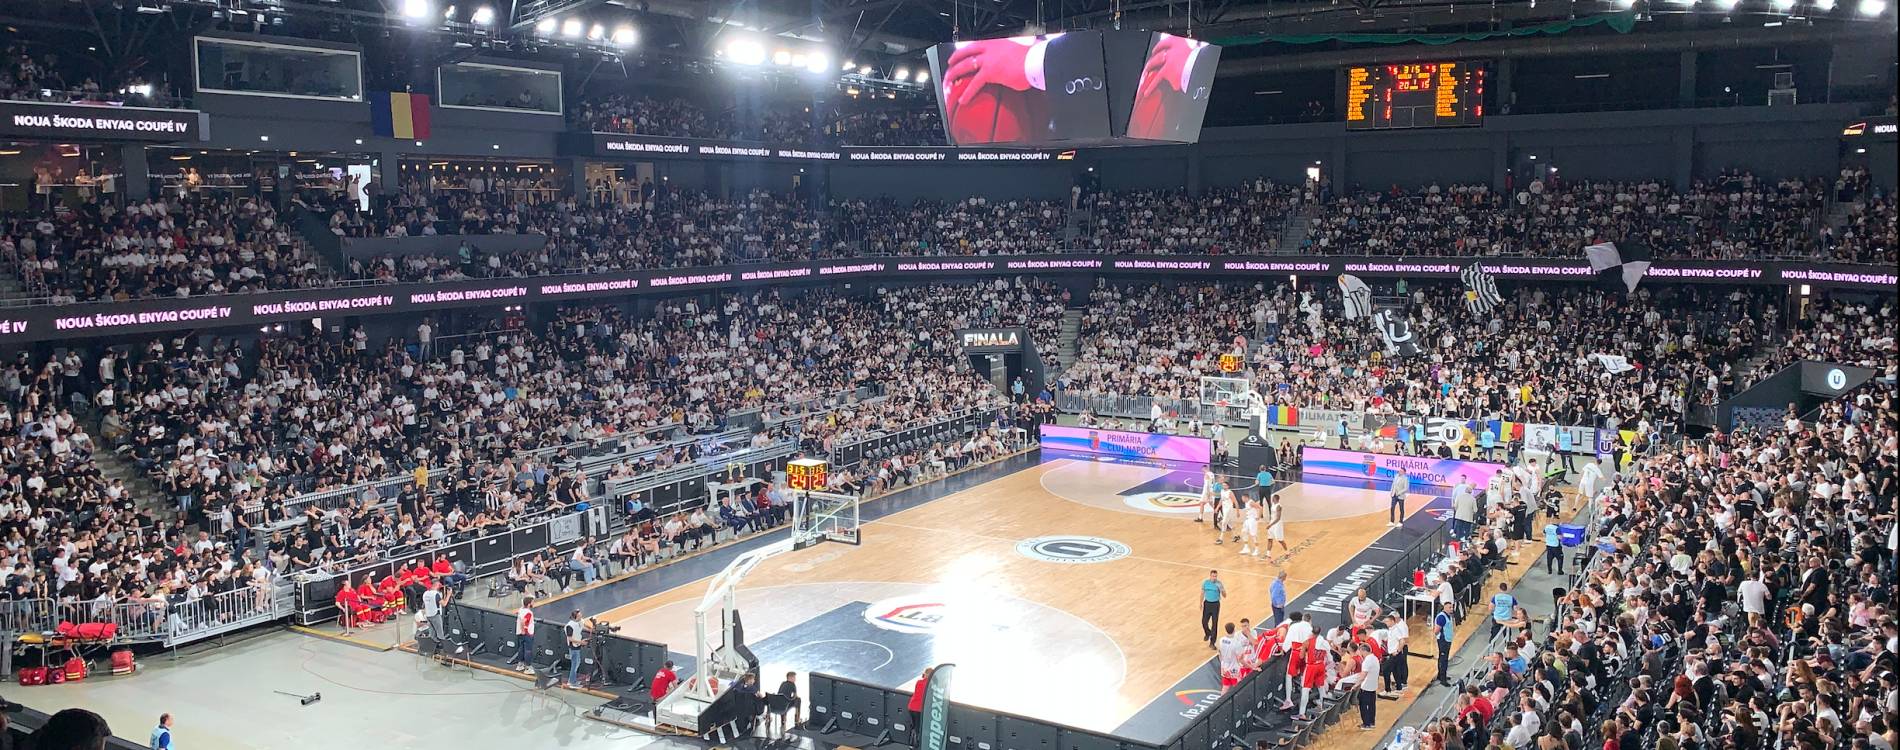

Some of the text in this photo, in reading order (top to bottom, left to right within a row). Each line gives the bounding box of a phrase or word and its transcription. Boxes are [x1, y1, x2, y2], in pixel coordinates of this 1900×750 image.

[14, 115, 50, 126] NOUA
[96, 119, 134, 130] ENYAQ
[176, 122, 186, 132] IV
[1782, 270, 1806, 279] NOUA
[1834, 273, 1859, 282] ENYAQ
[542, 285, 562, 294] NOUA
[586, 282, 608, 290] ENYAQ
[411, 293, 435, 302] NOUA
[465, 289, 490, 299] ENYAQ
[254, 304, 282, 314] NOUA
[319, 299, 349, 310] ENYAQ
[384, 296, 392, 305] IV
[56, 317, 93, 329] NOUA
[138, 311, 177, 323] ENYAQ
[220, 307, 230, 317] IV
[13, 321, 26, 332] IV
[964, 332, 1018, 346] FINALA
[1834, 376, 1840, 384] U
[1107, 434, 1142, 445] PRIMĂRIA
[1446, 428, 1456, 440] U
[1107, 444, 1156, 455] CLUJ-NAPOCA
[1386, 458, 1429, 470] PRIMĂRIA
[792, 474, 806, 488] 24
[814, 474, 824, 488] 24
[1386, 470, 1446, 483] CL-NAPOCA
